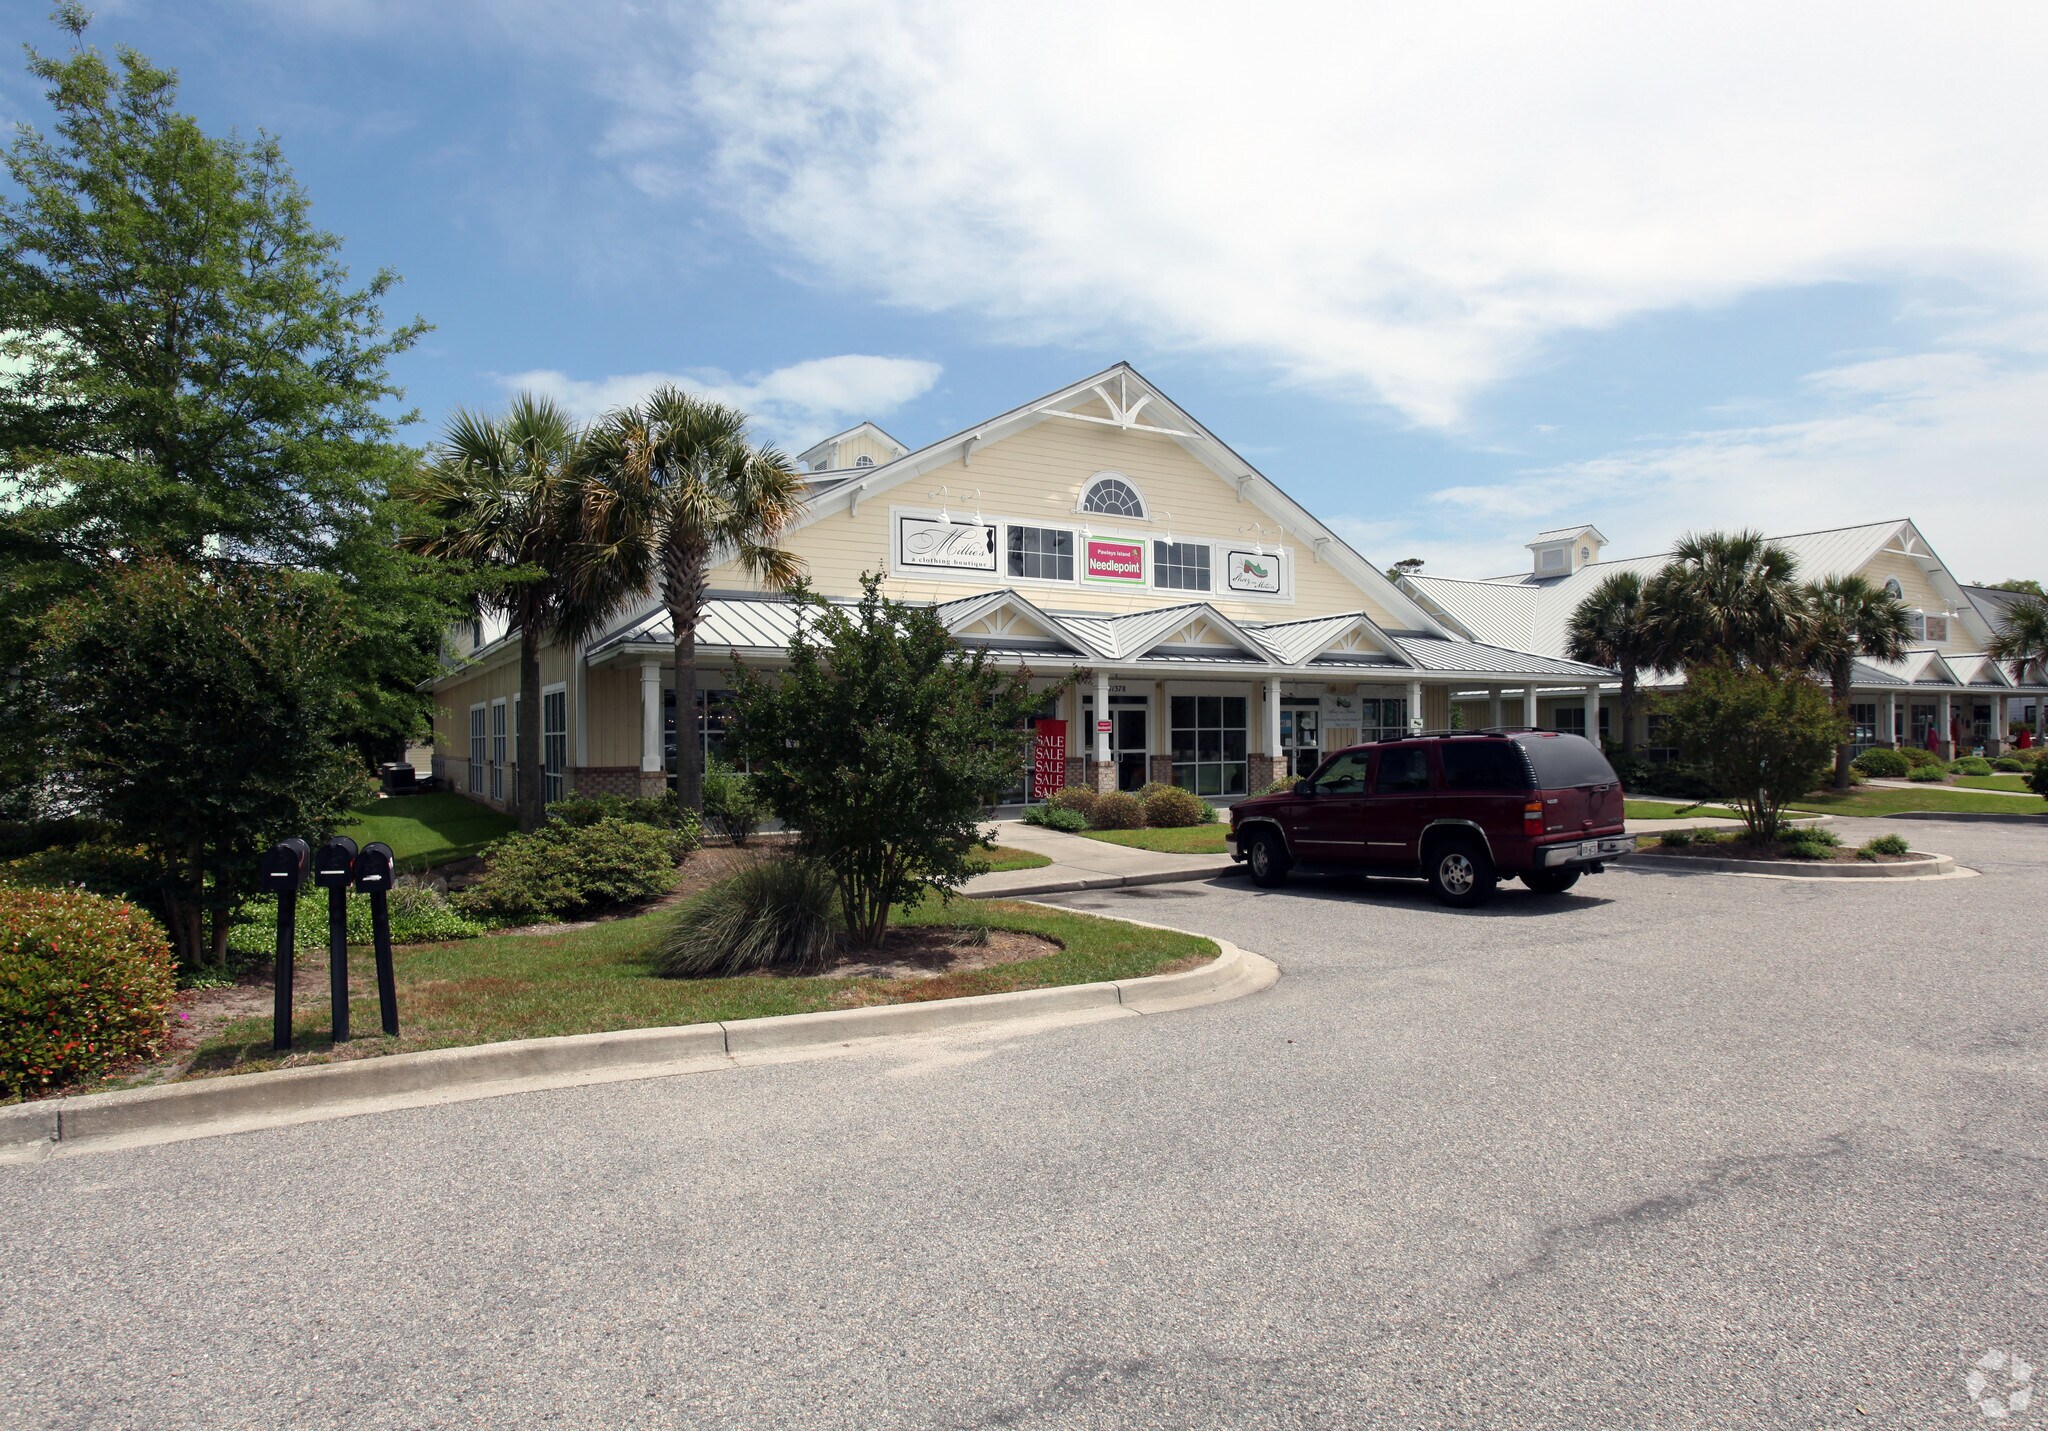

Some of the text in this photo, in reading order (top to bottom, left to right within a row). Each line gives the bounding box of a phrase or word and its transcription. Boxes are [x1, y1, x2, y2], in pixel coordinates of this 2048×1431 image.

[906, 528, 985, 556] Millie's
[1097, 549, 1117, 557] Pawleys
[918, 556, 951, 565] clothing
[953, 559, 988, 568] boutique
[1090, 558, 1140, 574] Needlepoint
[1036, 735, 1064, 748] SALE
[1035, 747, 1064, 760] SALE
[1035, 760, 1064, 773] SALE
[1034, 773, 1064, 786] SALE
